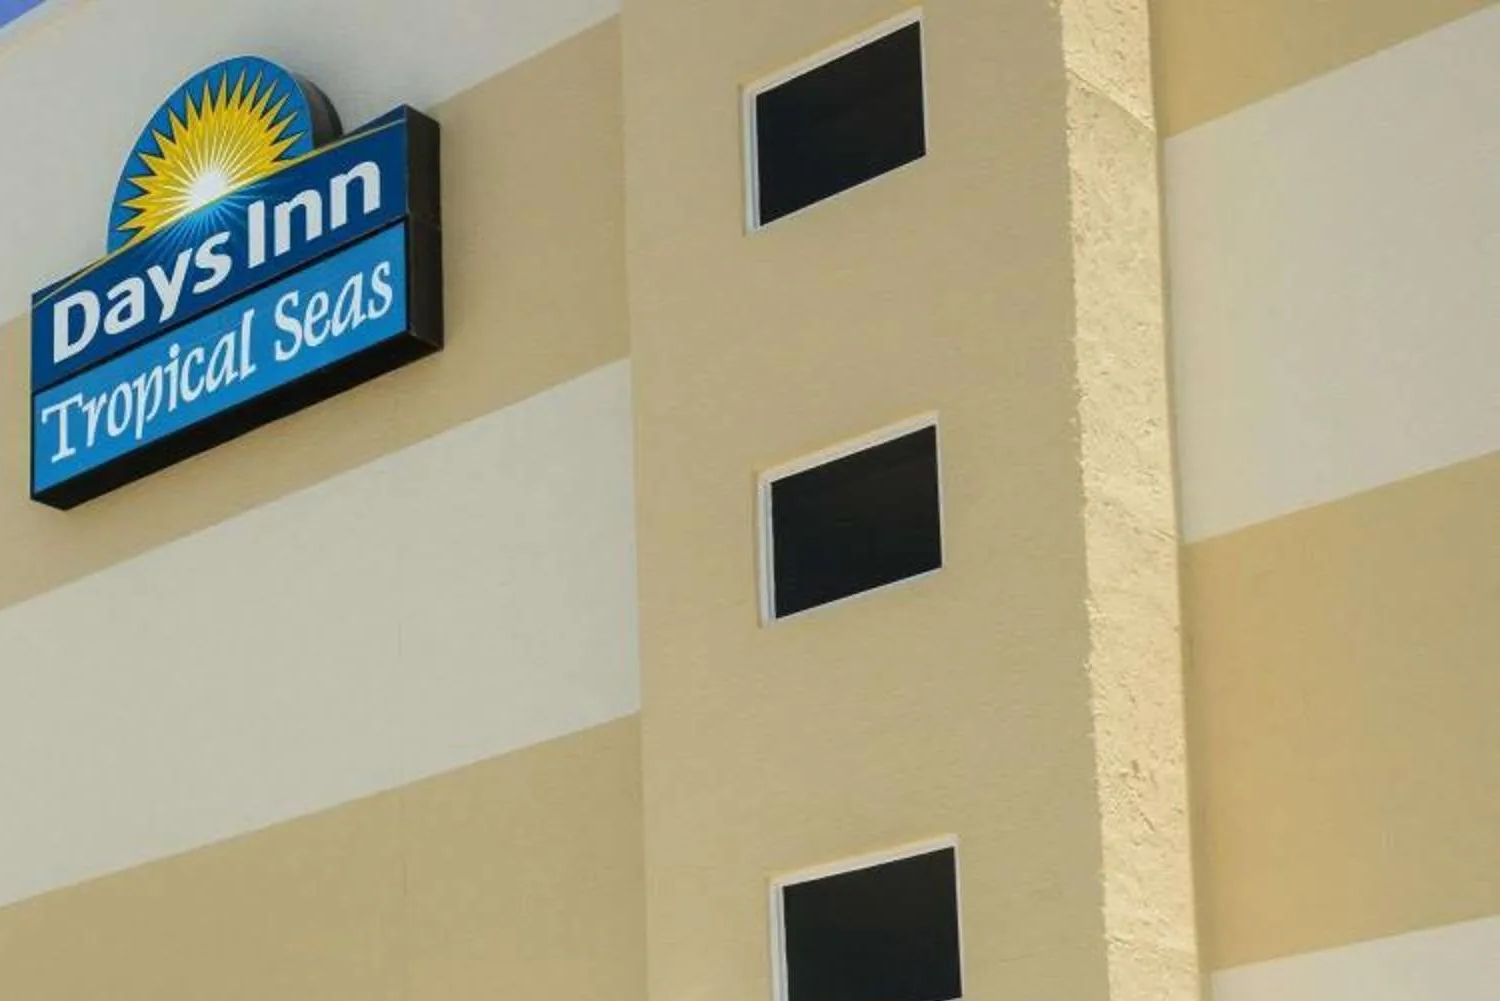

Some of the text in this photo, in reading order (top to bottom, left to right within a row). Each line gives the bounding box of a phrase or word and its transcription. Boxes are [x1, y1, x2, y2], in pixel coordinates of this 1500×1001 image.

[41, 260, 393, 463] Tropical Seas
[52, 160, 381, 364] Days Inn
